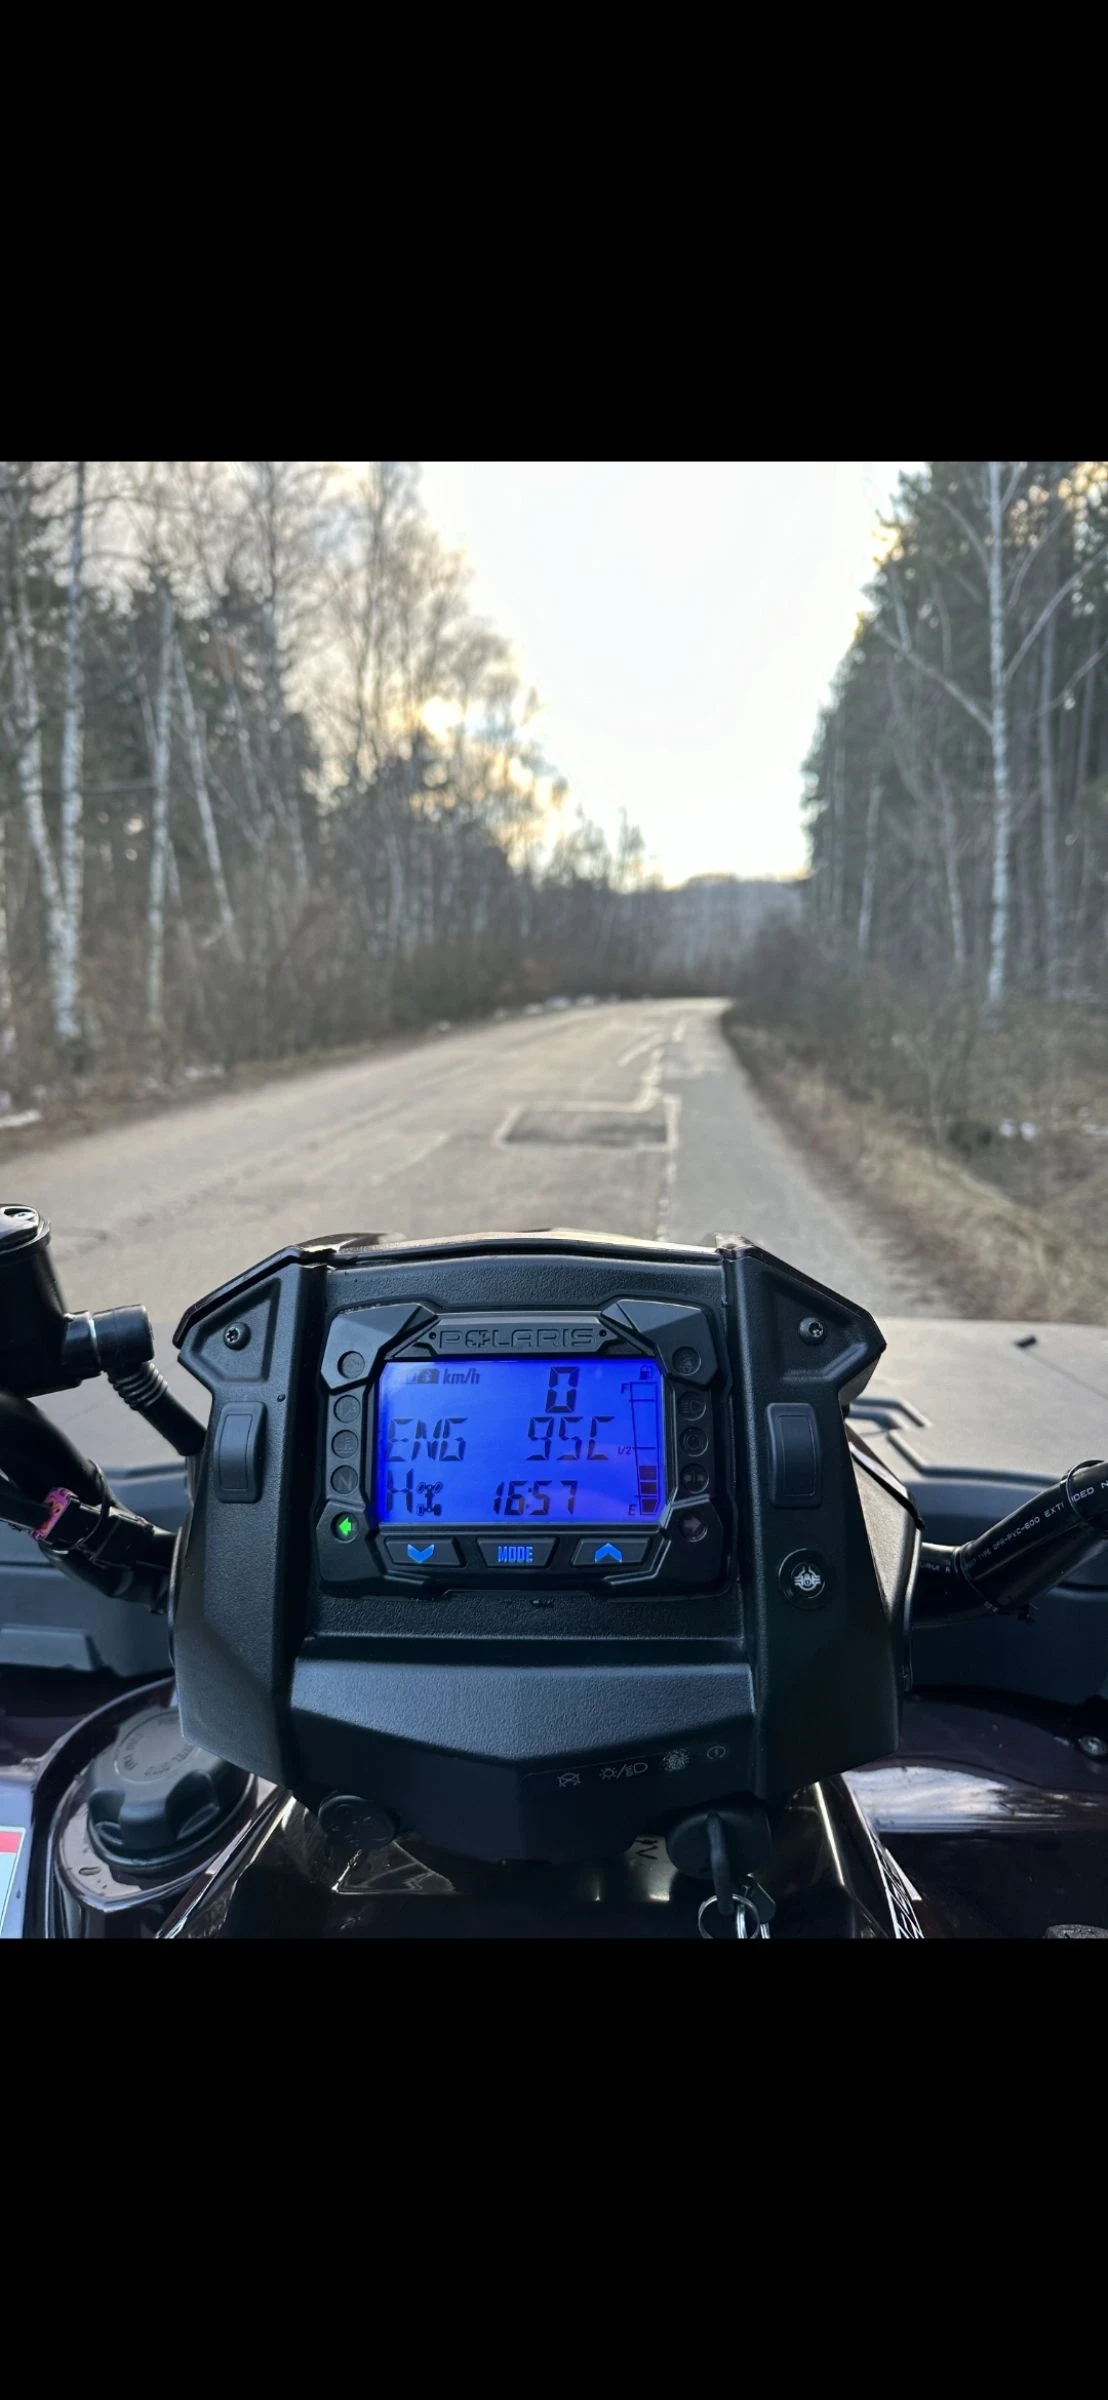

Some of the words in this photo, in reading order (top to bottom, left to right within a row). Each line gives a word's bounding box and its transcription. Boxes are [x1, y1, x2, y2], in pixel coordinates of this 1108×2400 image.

[438, 1328, 594, 1349] POLARIS
[442, 1367, 481, 1385] km/h
[545, 1366, 581, 1413] 0
[620, 1383, 629, 1394] F
[386, 1418, 468, 1462] ENG
[525, 1416, 616, 1461] 95C
[385, 1468, 414, 1514] H
[493, 1480, 578, 1516] 16:57
[628, 1503, 638, 1516] E
[497, 1545, 534, 1564] MODE
